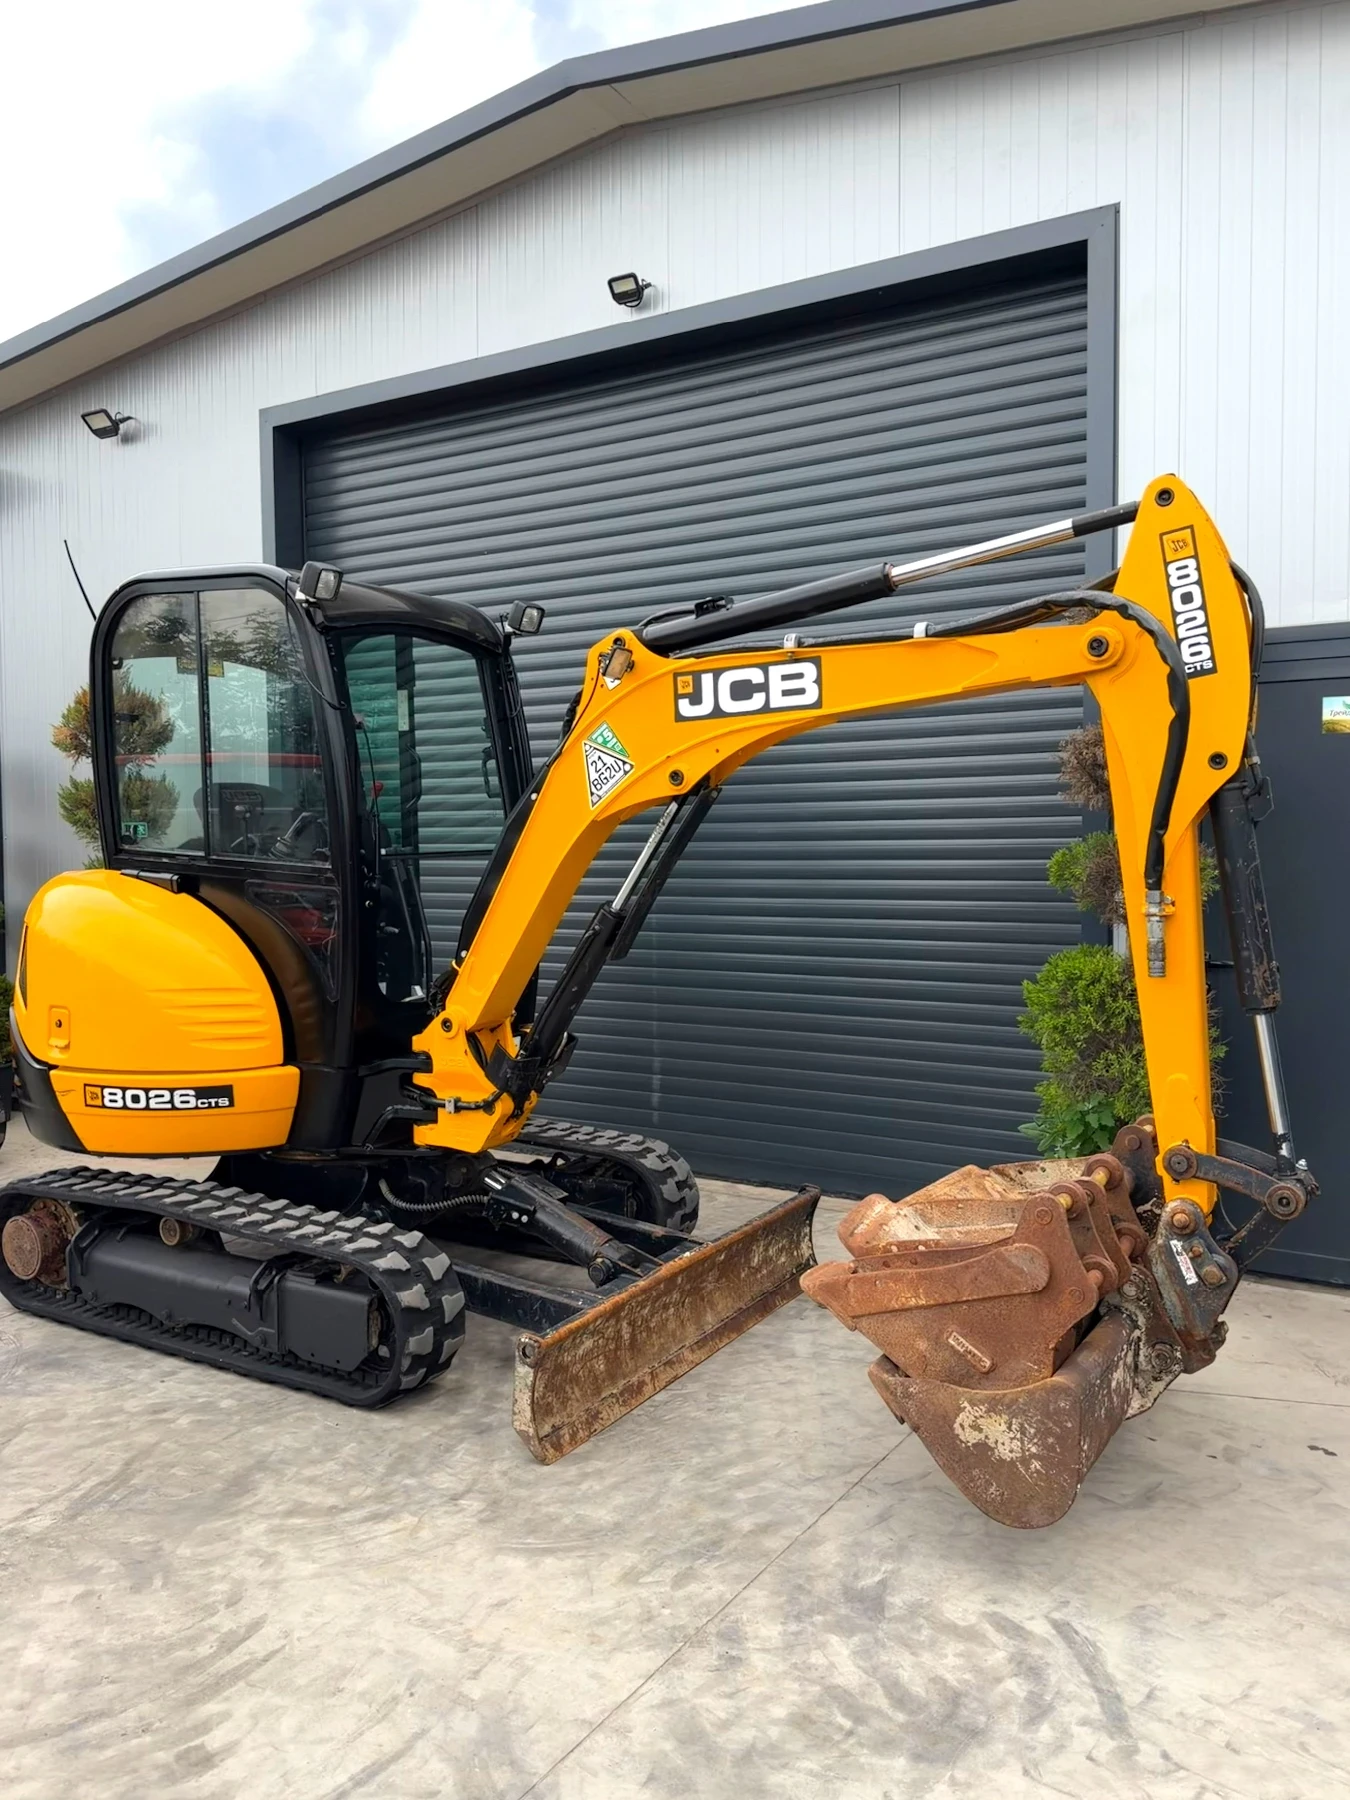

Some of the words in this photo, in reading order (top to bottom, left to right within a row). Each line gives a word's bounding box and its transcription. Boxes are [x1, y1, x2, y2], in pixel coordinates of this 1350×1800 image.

[678, 662, 819, 717] JCB
[590, 755, 607, 774] 21
[591, 760, 622, 792] BG2U
